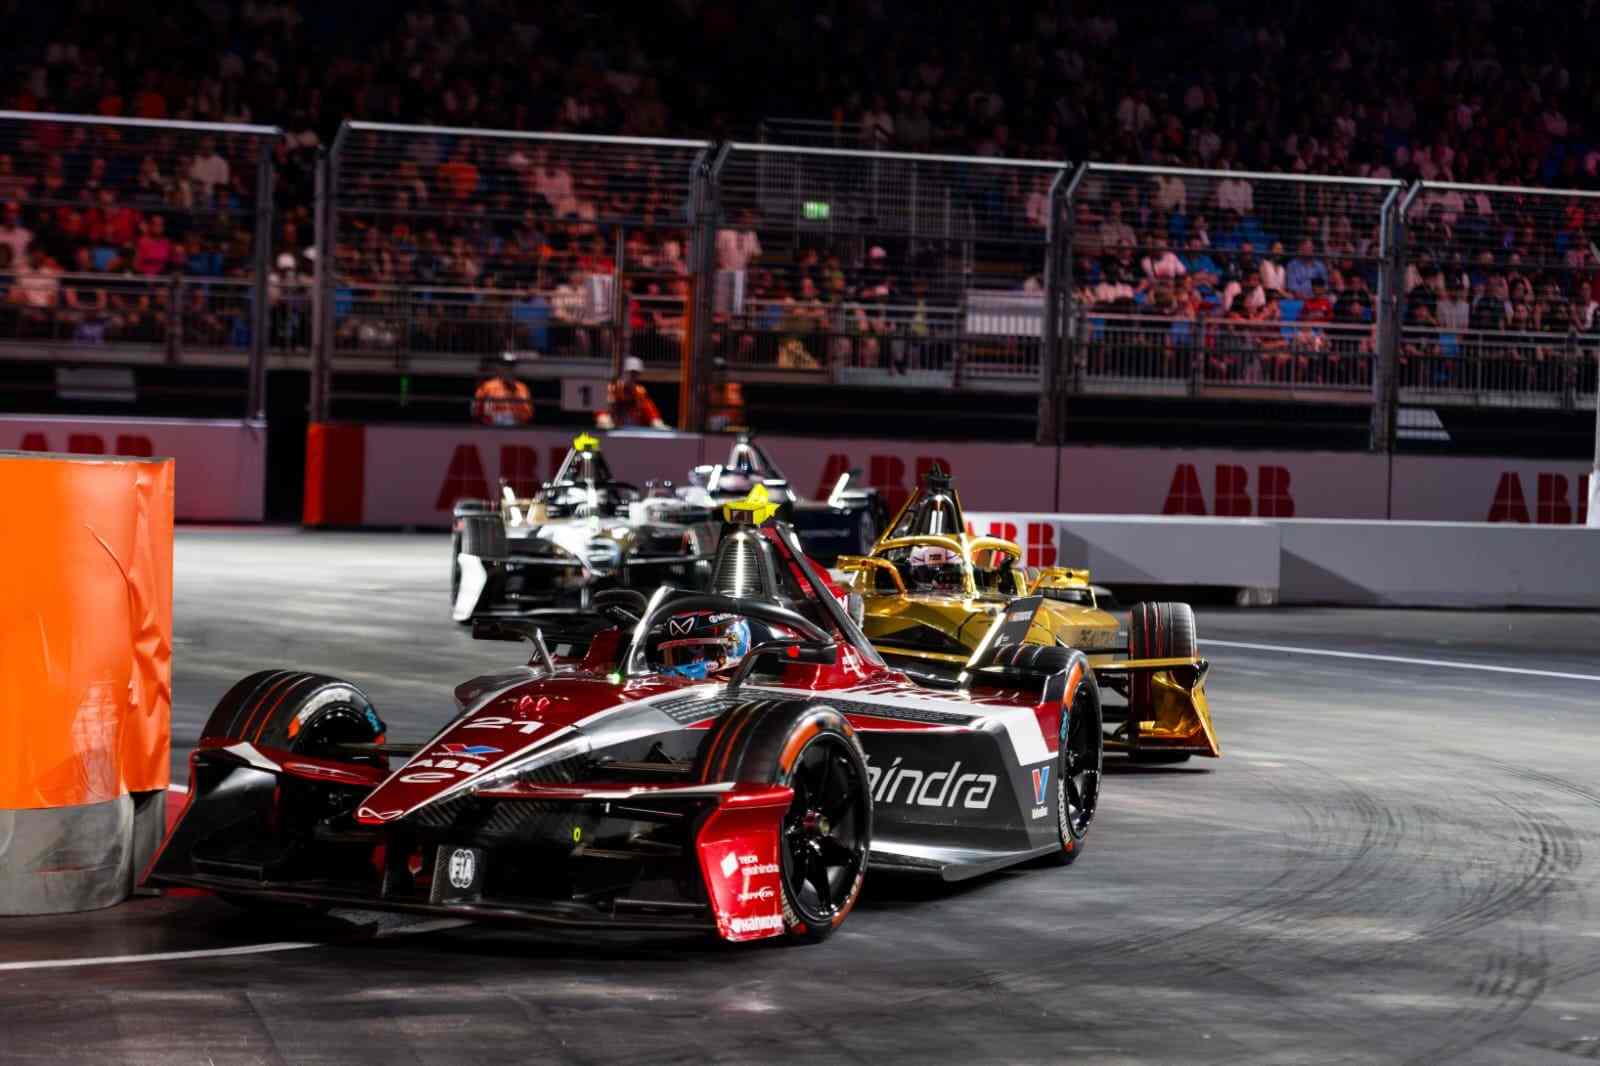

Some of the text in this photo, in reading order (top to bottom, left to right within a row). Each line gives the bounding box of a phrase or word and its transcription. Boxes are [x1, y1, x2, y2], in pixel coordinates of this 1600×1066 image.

[1162, 463, 1296, 518] ABB
[1487, 471, 1588, 525] AB
[462, 716, 545, 735] 21
